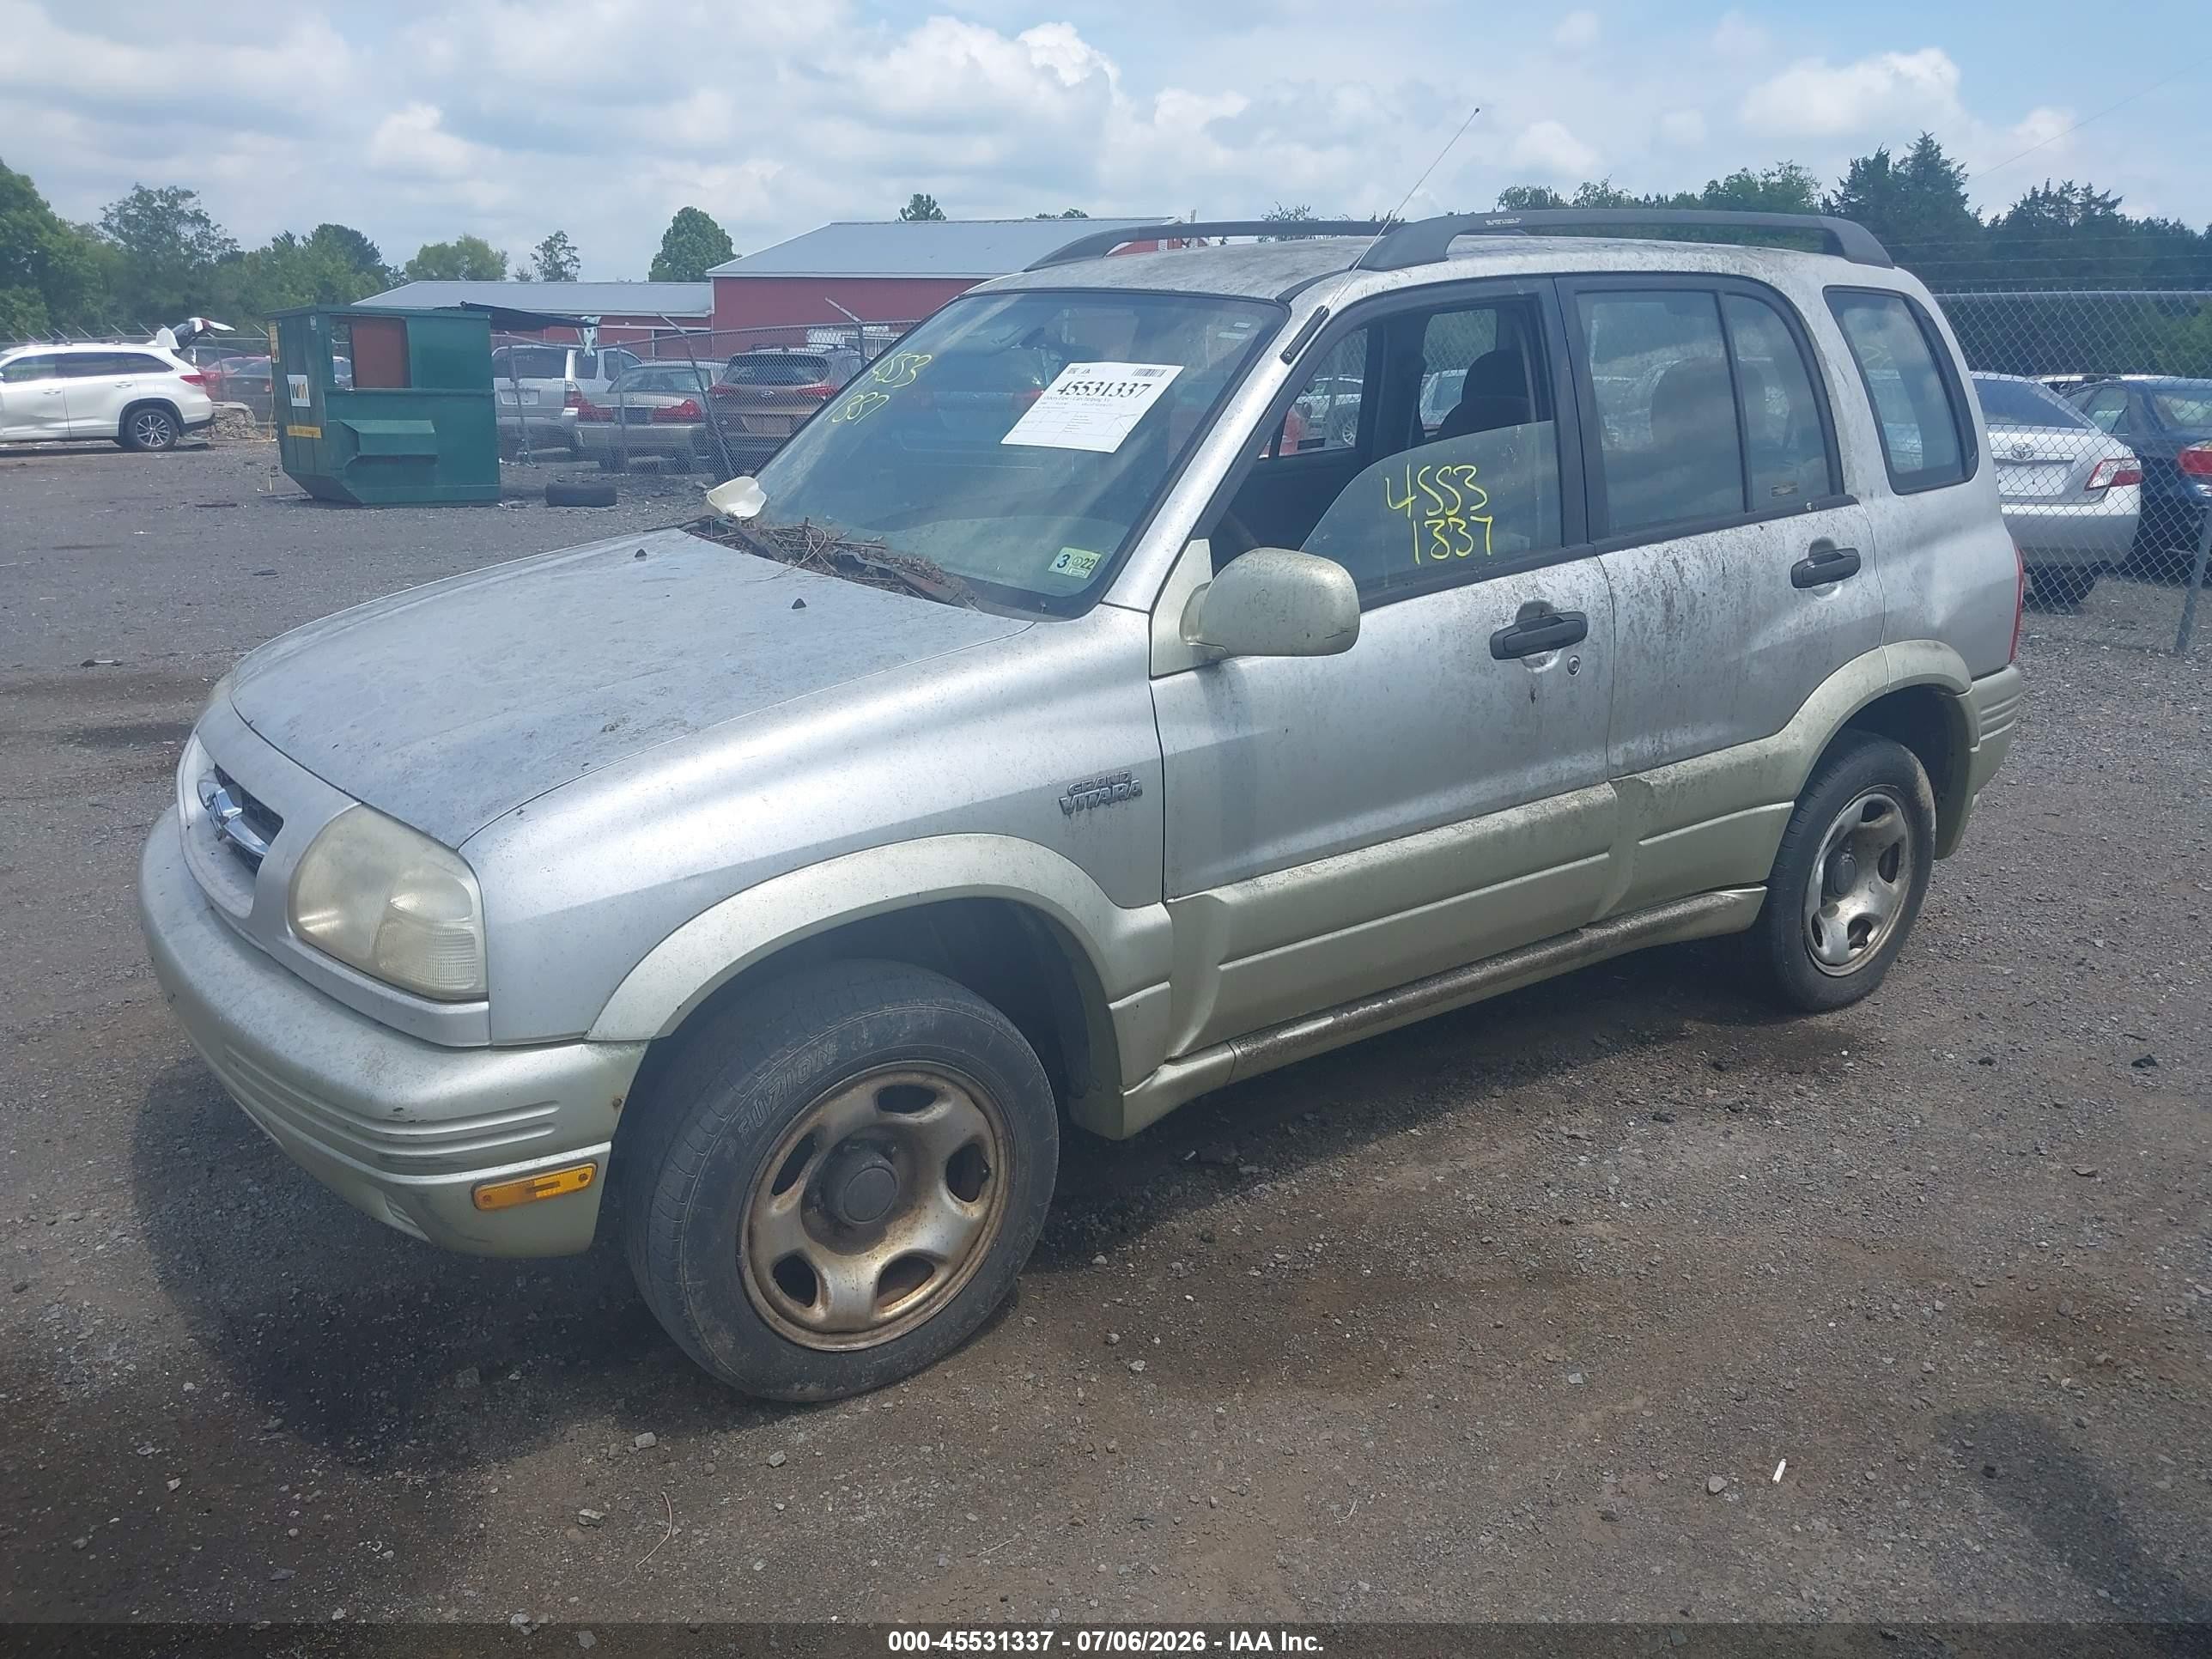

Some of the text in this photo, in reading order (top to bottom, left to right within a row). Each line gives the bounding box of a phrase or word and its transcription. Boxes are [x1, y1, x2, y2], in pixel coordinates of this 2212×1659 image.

[1056, 380, 1154, 398] 45531337
[1384, 462, 1488, 519] 4553
[1057, 554, 1095, 569] 3 22
[1058, 779, 1143, 816] VITARA
[1067, 769, 1133, 796] GRAND
[738, 1042, 838, 1146] FUZION
